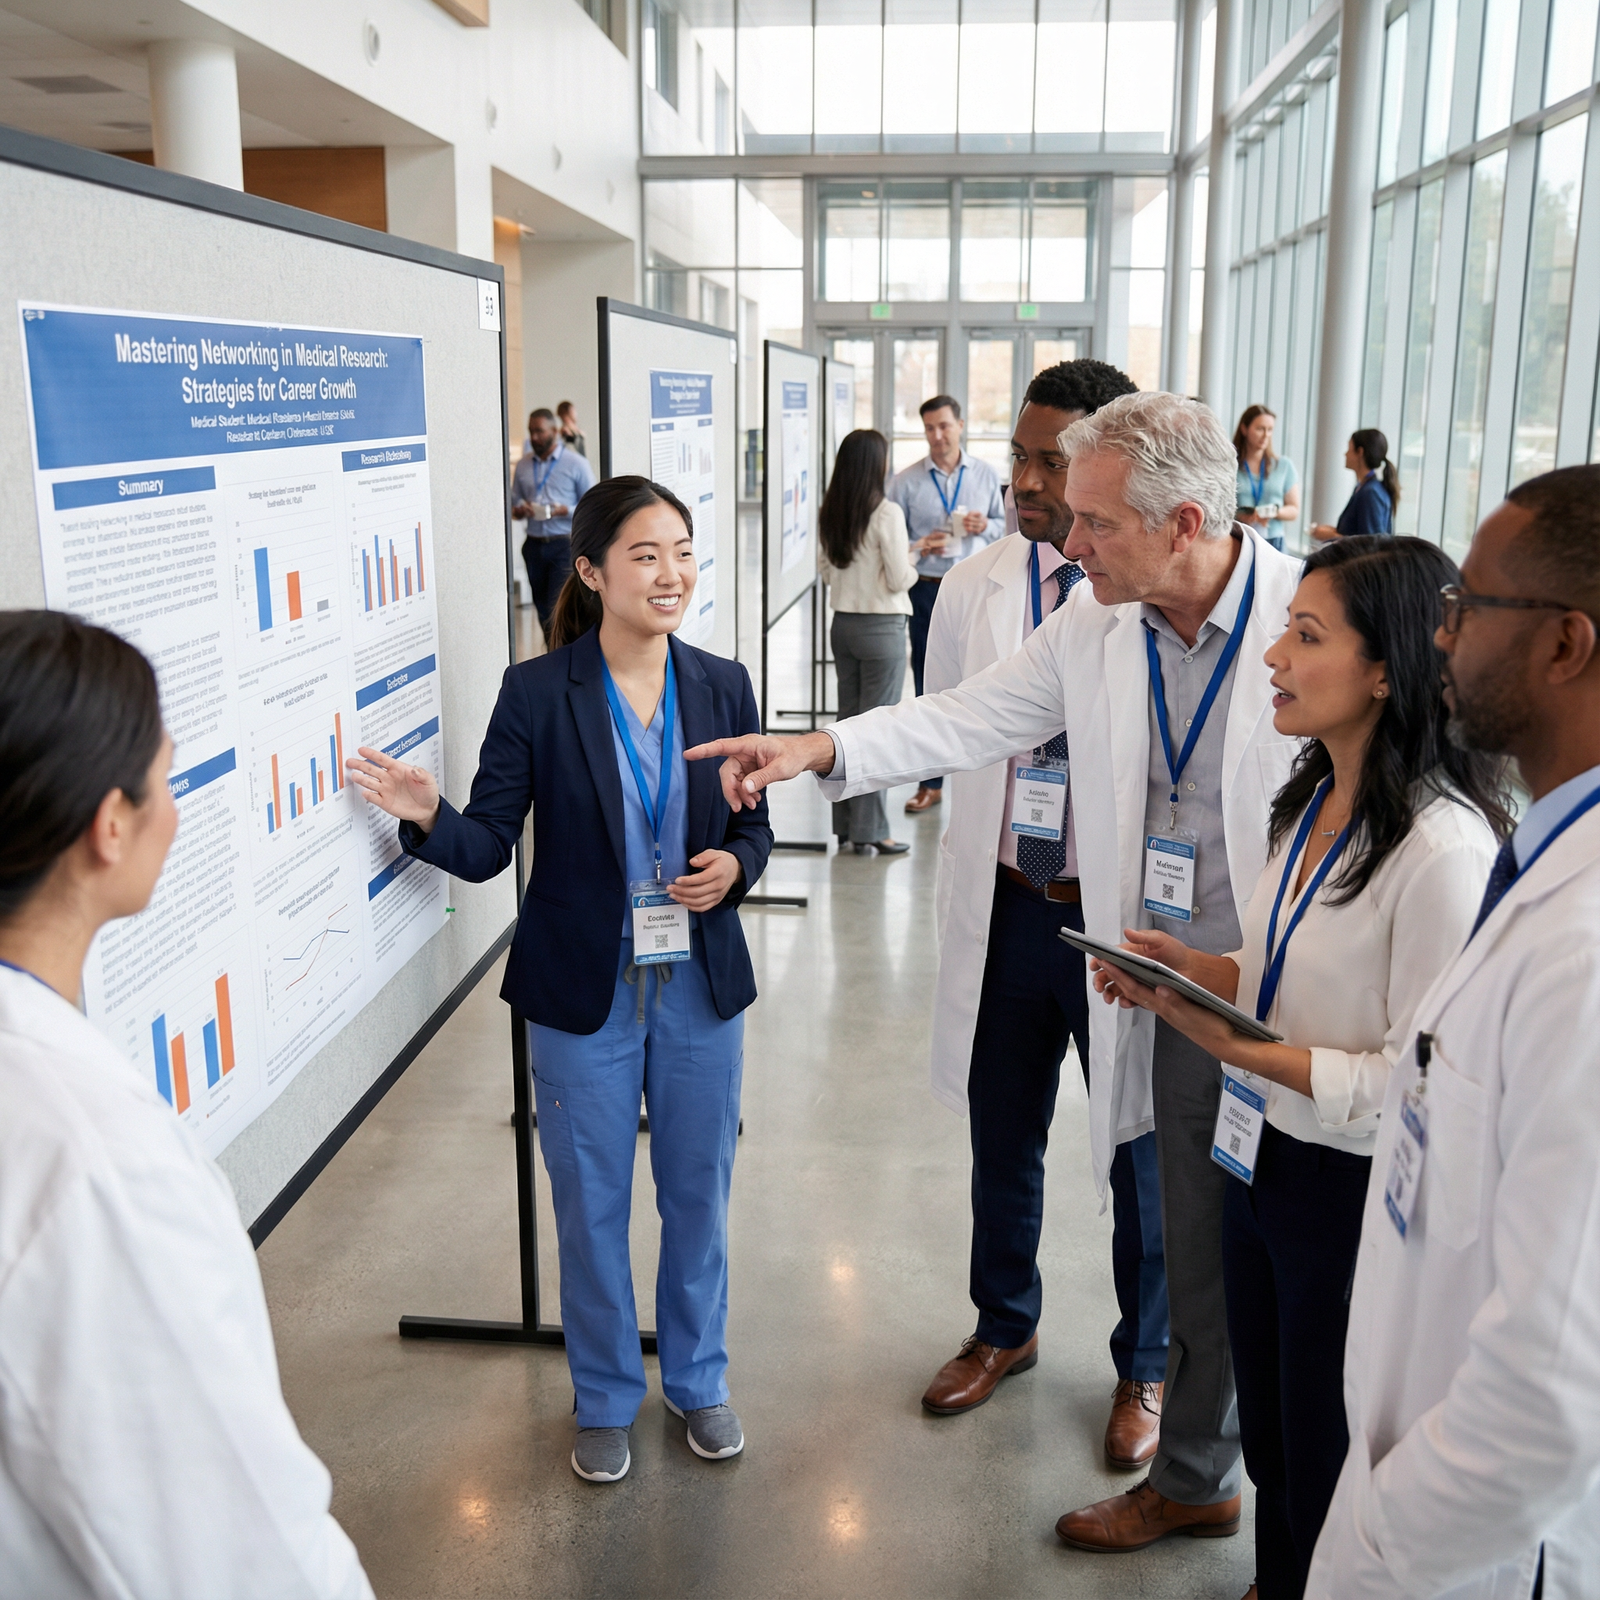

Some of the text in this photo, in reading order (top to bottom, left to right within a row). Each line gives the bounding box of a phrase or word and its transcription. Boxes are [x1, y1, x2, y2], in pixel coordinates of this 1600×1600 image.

[115, 333, 388, 372] Mastering Networking in Medical Research:
[182, 377, 357, 409] Strategies for Career Growth
[118, 479, 164, 496] Summary
